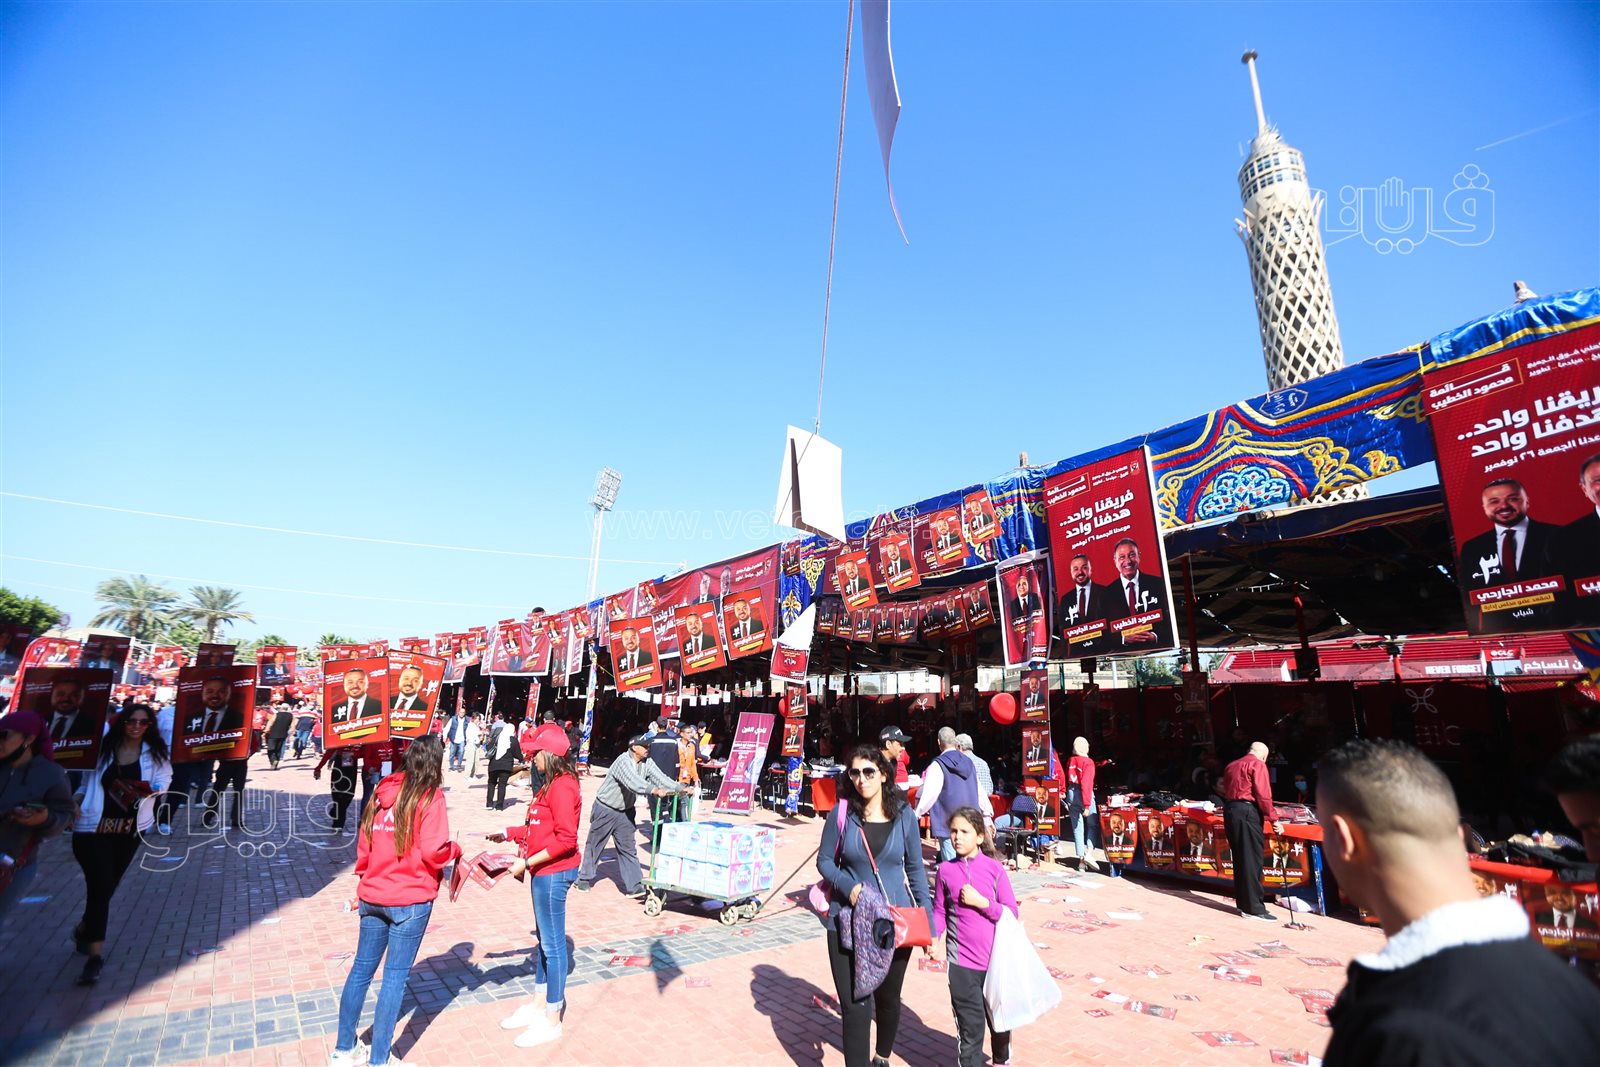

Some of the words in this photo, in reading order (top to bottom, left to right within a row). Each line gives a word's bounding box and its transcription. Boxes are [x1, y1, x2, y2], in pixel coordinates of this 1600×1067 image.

[1474, 376, 1514, 395] محمود
[1431, 388, 1472, 410] الخطيب
[1534, 386, 1600, 416] ريقنا
[1471, 431, 1528, 457] واحد
[1578, 434, 1600, 446] عدنا
[1537, 440, 1577, 456] الجمعة
[1484, 455, 1518, 473] نوفمبر
[1094, 489, 1134, 513] فريقنا
[1093, 508, 1131, 528] هدفنا
[1065, 522, 1092, 539] واحد
[1476, 585, 1523, 602] الجارحي
[1525, 580, 1559, 593] محمد
[1137, 613, 1161, 624] محمود
[1512, 607, 1534, 618] شباب
[1089, 622, 1104, 630] محمد
[1113, 617, 1137, 630] الخطيب
[1424, 665, 1452, 675] NEVER
[1523, 659, 1569, 673] ننساكم
[184, 733, 219, 746] الجارحي
[220, 731, 243, 739] محمد
